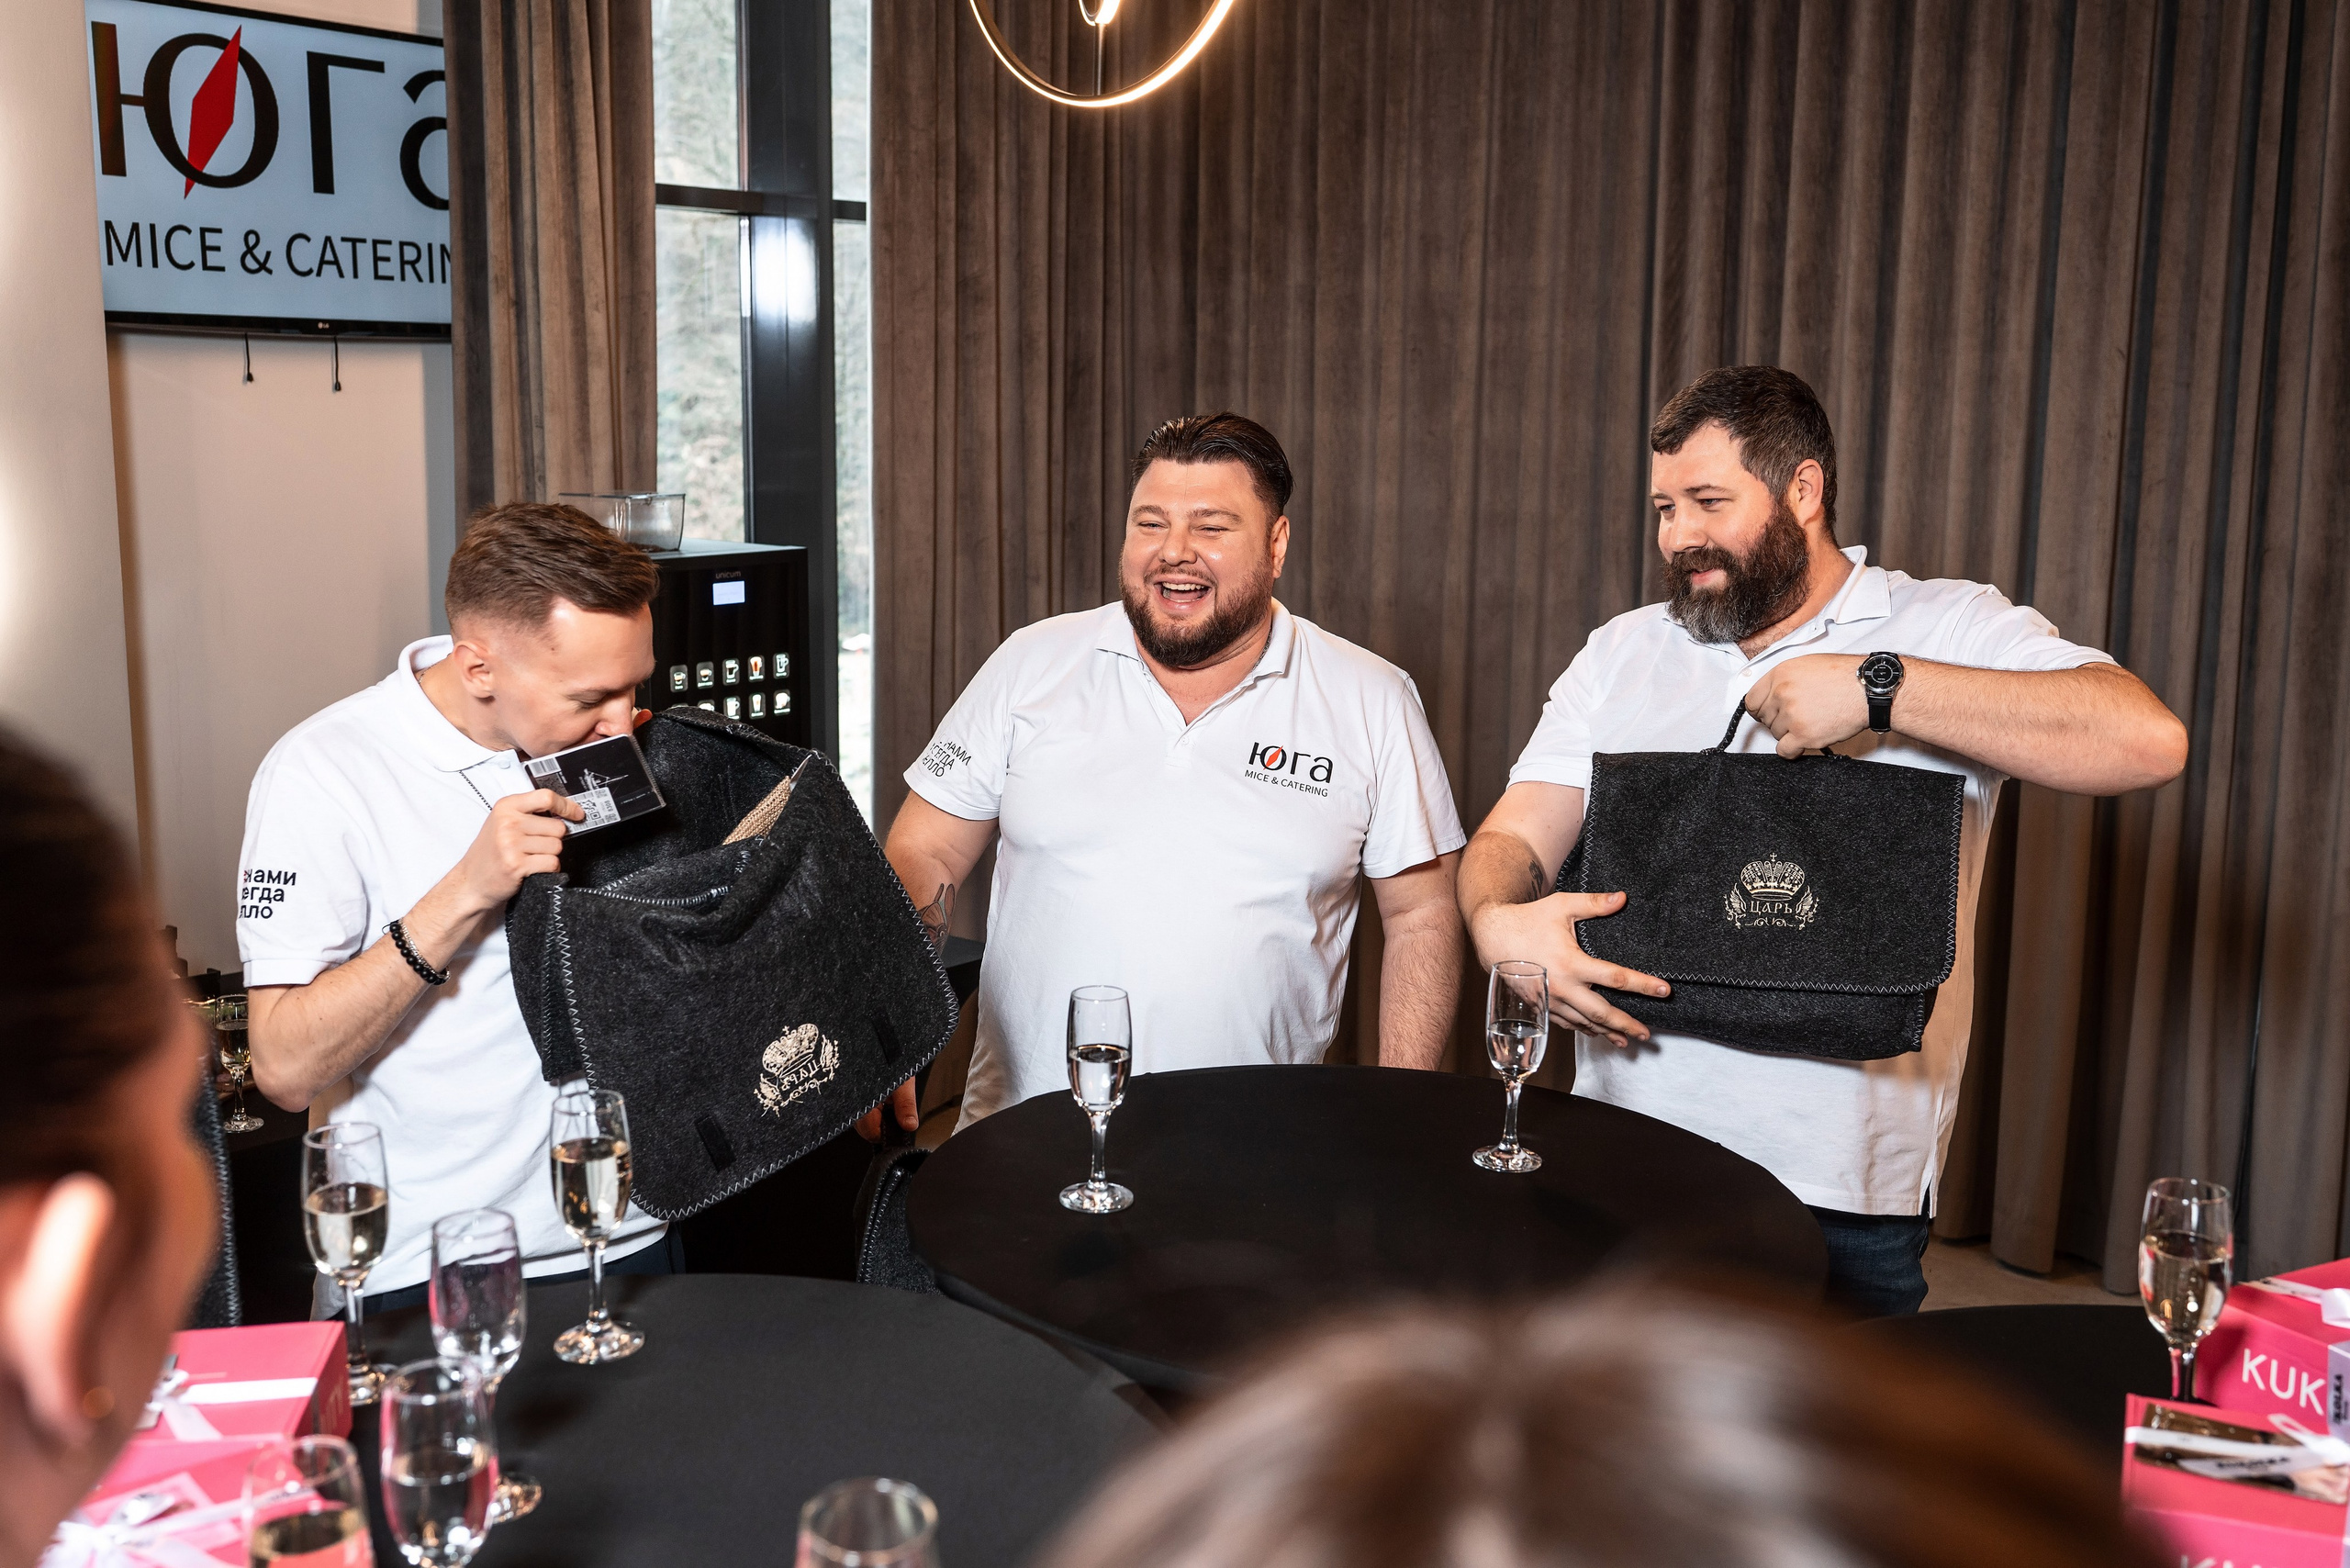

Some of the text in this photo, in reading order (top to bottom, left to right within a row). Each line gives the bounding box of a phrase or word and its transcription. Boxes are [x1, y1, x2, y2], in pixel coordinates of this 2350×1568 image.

[104, 219, 226, 272] MICE
[240, 230, 274, 275] &
[1244, 769, 1329, 798] MICE & CATERING
[1749, 901, 1793, 916] ЦАРЬ
